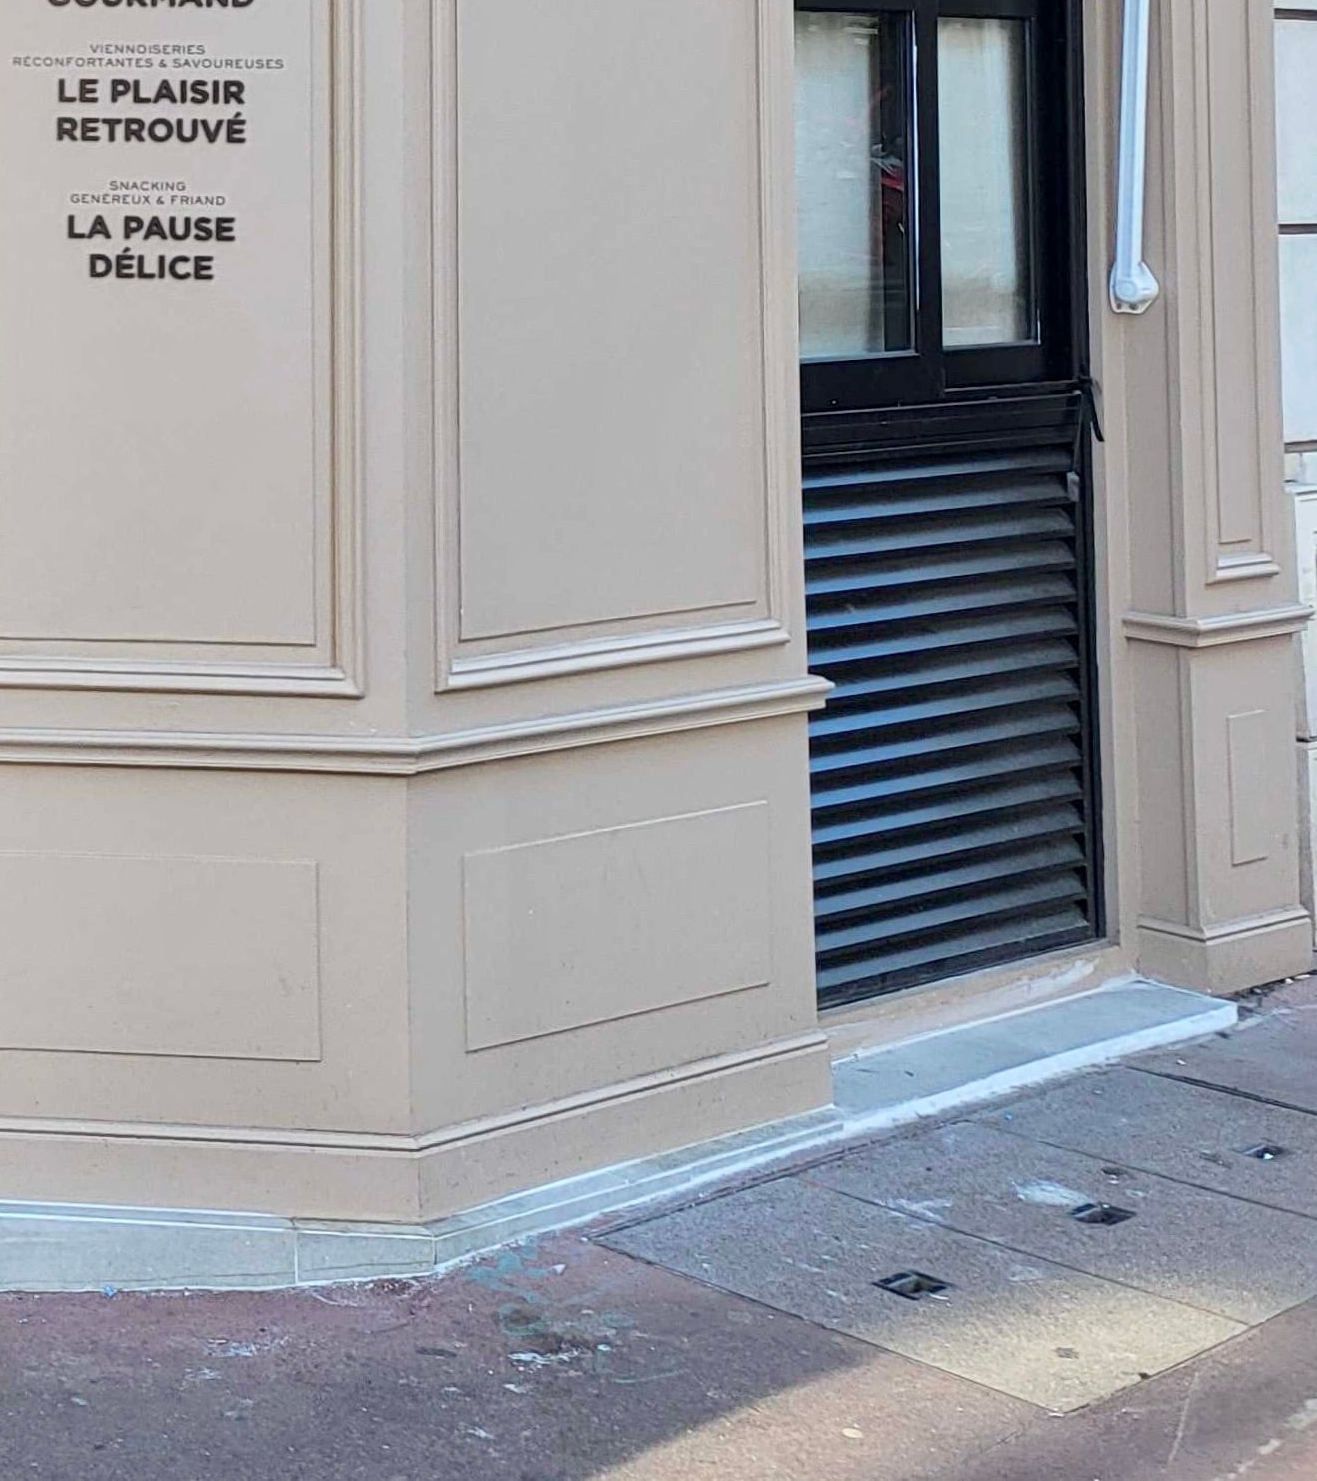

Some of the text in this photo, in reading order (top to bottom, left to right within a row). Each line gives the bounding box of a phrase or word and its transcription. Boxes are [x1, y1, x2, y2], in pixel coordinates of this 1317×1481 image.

[89, 44, 206, 55] VIENNOISERIES
[158, 58, 168, 68] &
[172, 58, 284, 69] SAVOUREUSES
[58, 78, 245, 105] LE PLAISIR
[56, 111, 247, 144] RETROUVÉ
[109, 180, 186, 192] SNACKING
[155, 195, 165, 206] &
[170, 195, 226, 206] FRIAND
[67, 215, 236, 242] LA PAUSE
[88, 247, 214, 281] DÉLICE
